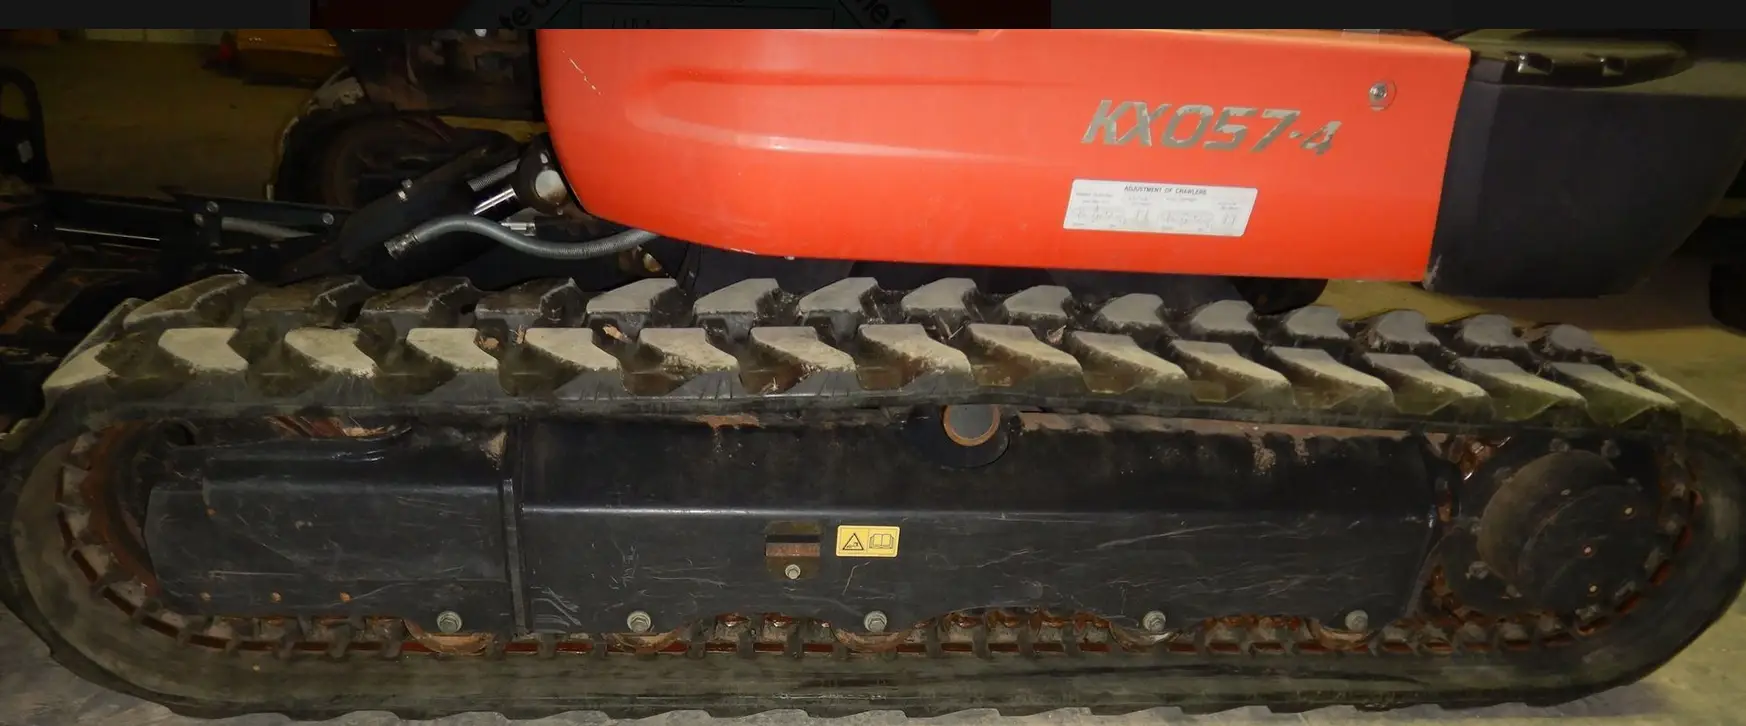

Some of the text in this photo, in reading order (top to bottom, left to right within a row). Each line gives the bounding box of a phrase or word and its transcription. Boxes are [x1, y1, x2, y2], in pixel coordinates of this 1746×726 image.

[1081, 99, 1342, 155] KX057-4
[1124, 185, 1162, 193] ADJUSTMENT
[1175, 188, 1207, 196] CRAWLERS
